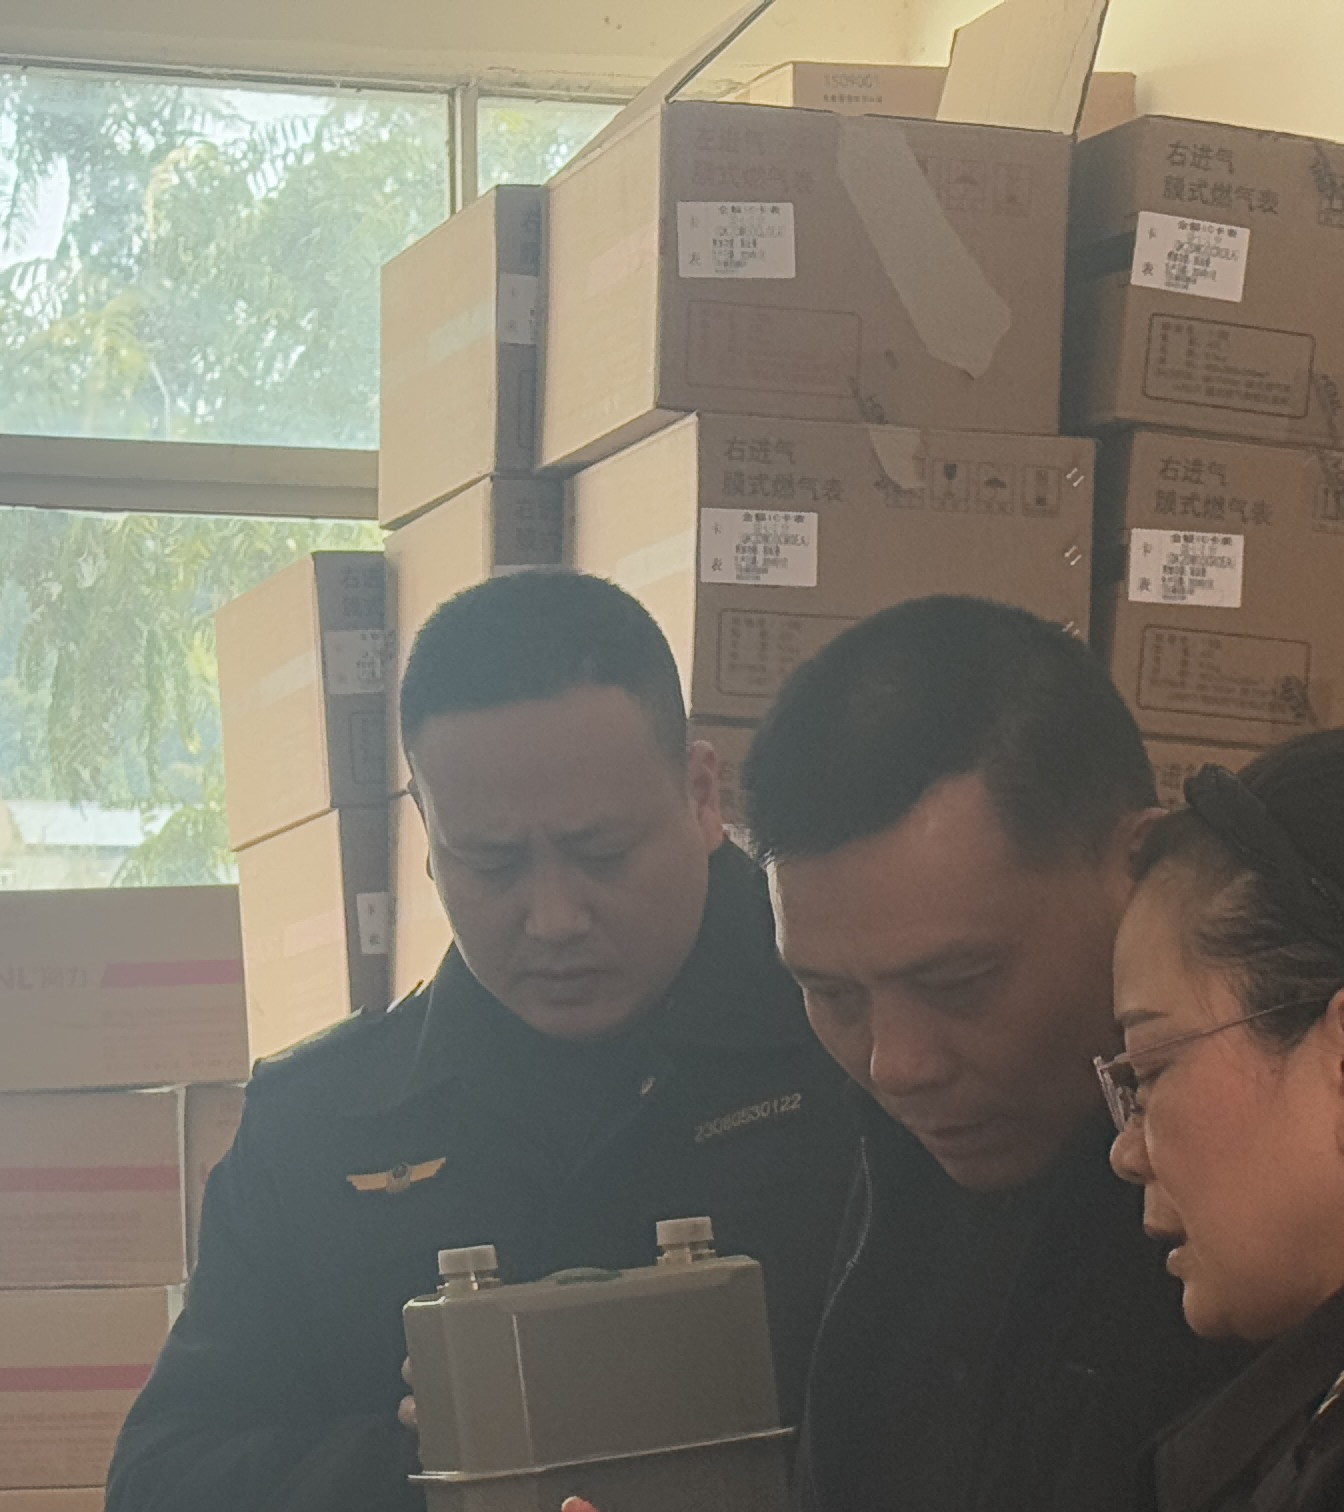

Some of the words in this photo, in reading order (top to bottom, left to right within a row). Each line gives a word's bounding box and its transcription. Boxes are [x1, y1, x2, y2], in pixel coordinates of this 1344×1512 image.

[1168, 140, 1236, 175] 右进气
[1164, 174, 1279, 215] 膜式燃气表
[722, 436, 796, 466] 右进气
[722, 470, 845, 504] 膜式燃气表
[1159, 457, 1227, 488] 右进气
[1154, 488, 1274, 526] 膜式燃气表
